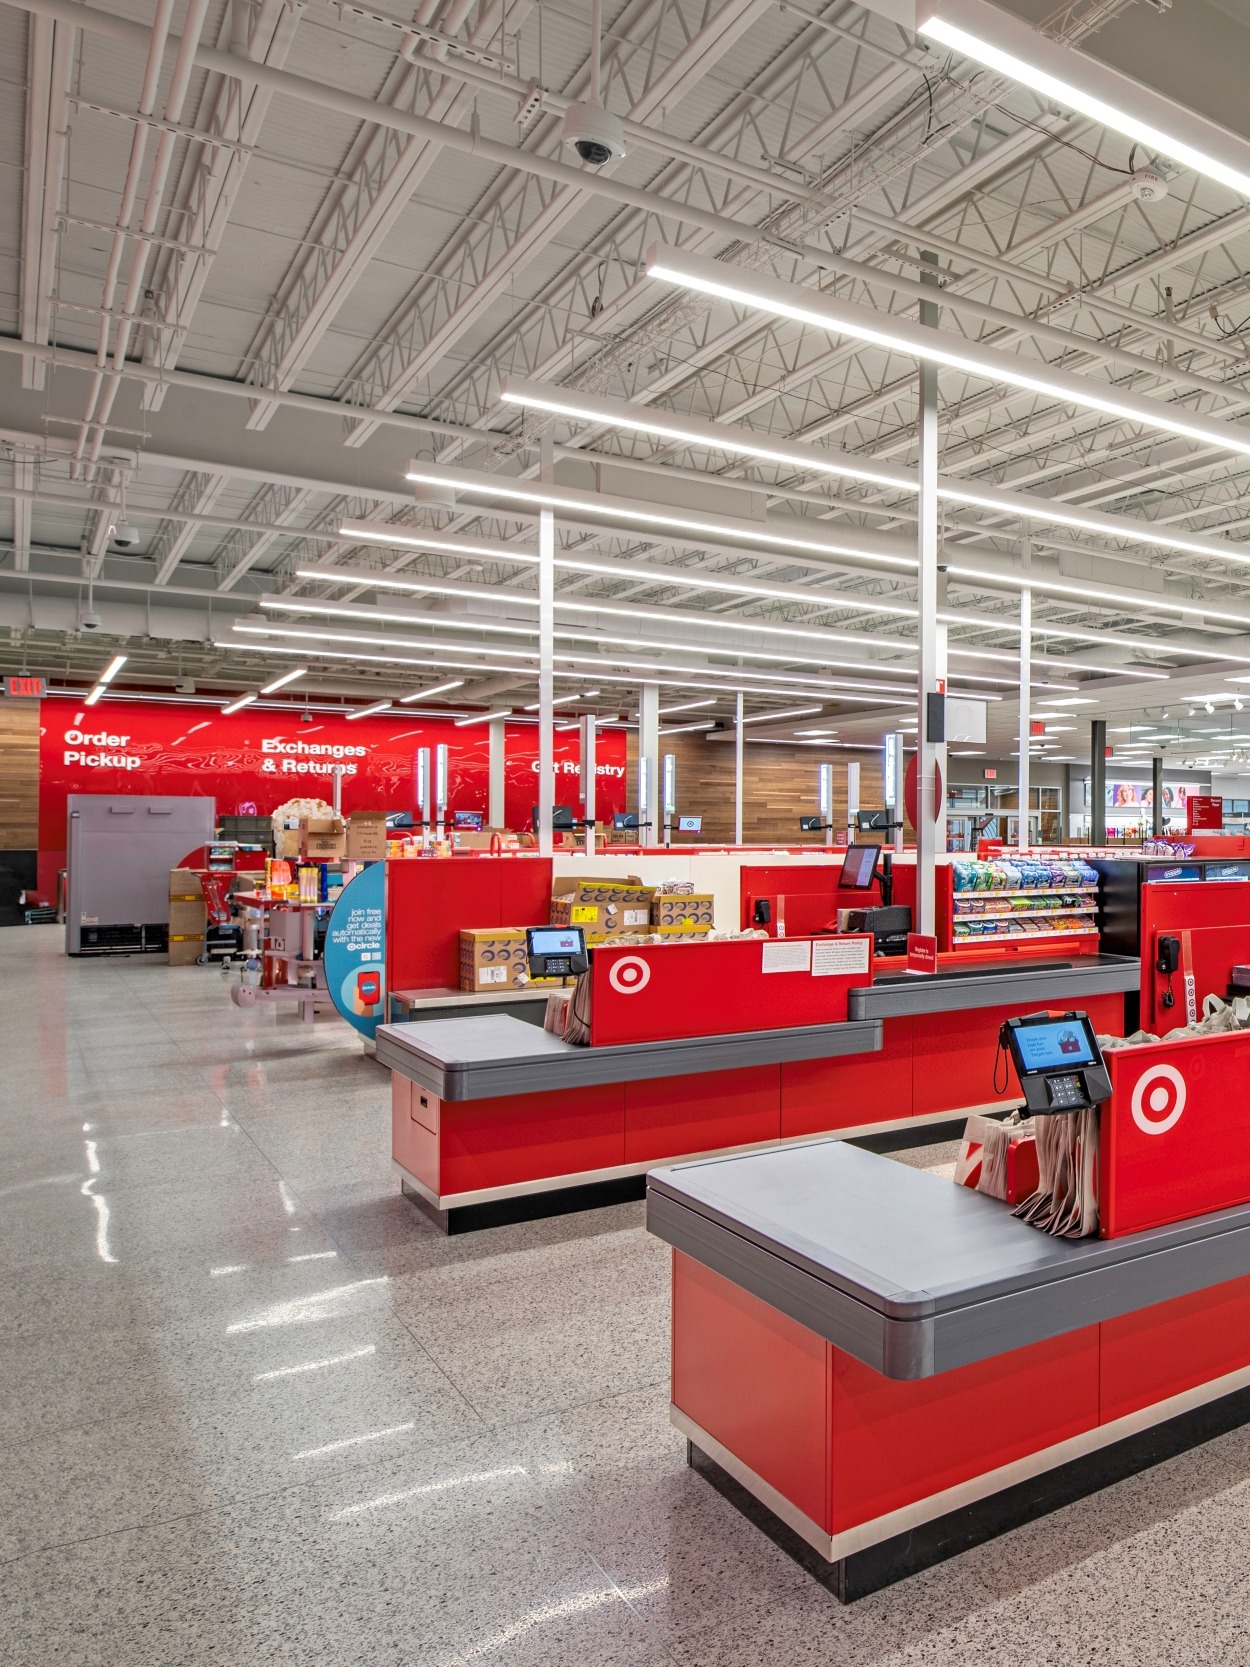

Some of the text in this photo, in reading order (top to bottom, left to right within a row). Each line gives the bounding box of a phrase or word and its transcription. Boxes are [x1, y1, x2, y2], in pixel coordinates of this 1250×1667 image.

[9, 677, 40, 696] EXIT
[64, 730, 130, 747] Order
[262, 738, 366, 758] Exchanges
[64, 751, 141, 770] Pickup
[262, 758, 358, 775] & Returns
[531, 760, 560, 774] Gt
[332, 928, 382, 937] automatically
[346, 922, 360, 930] get
